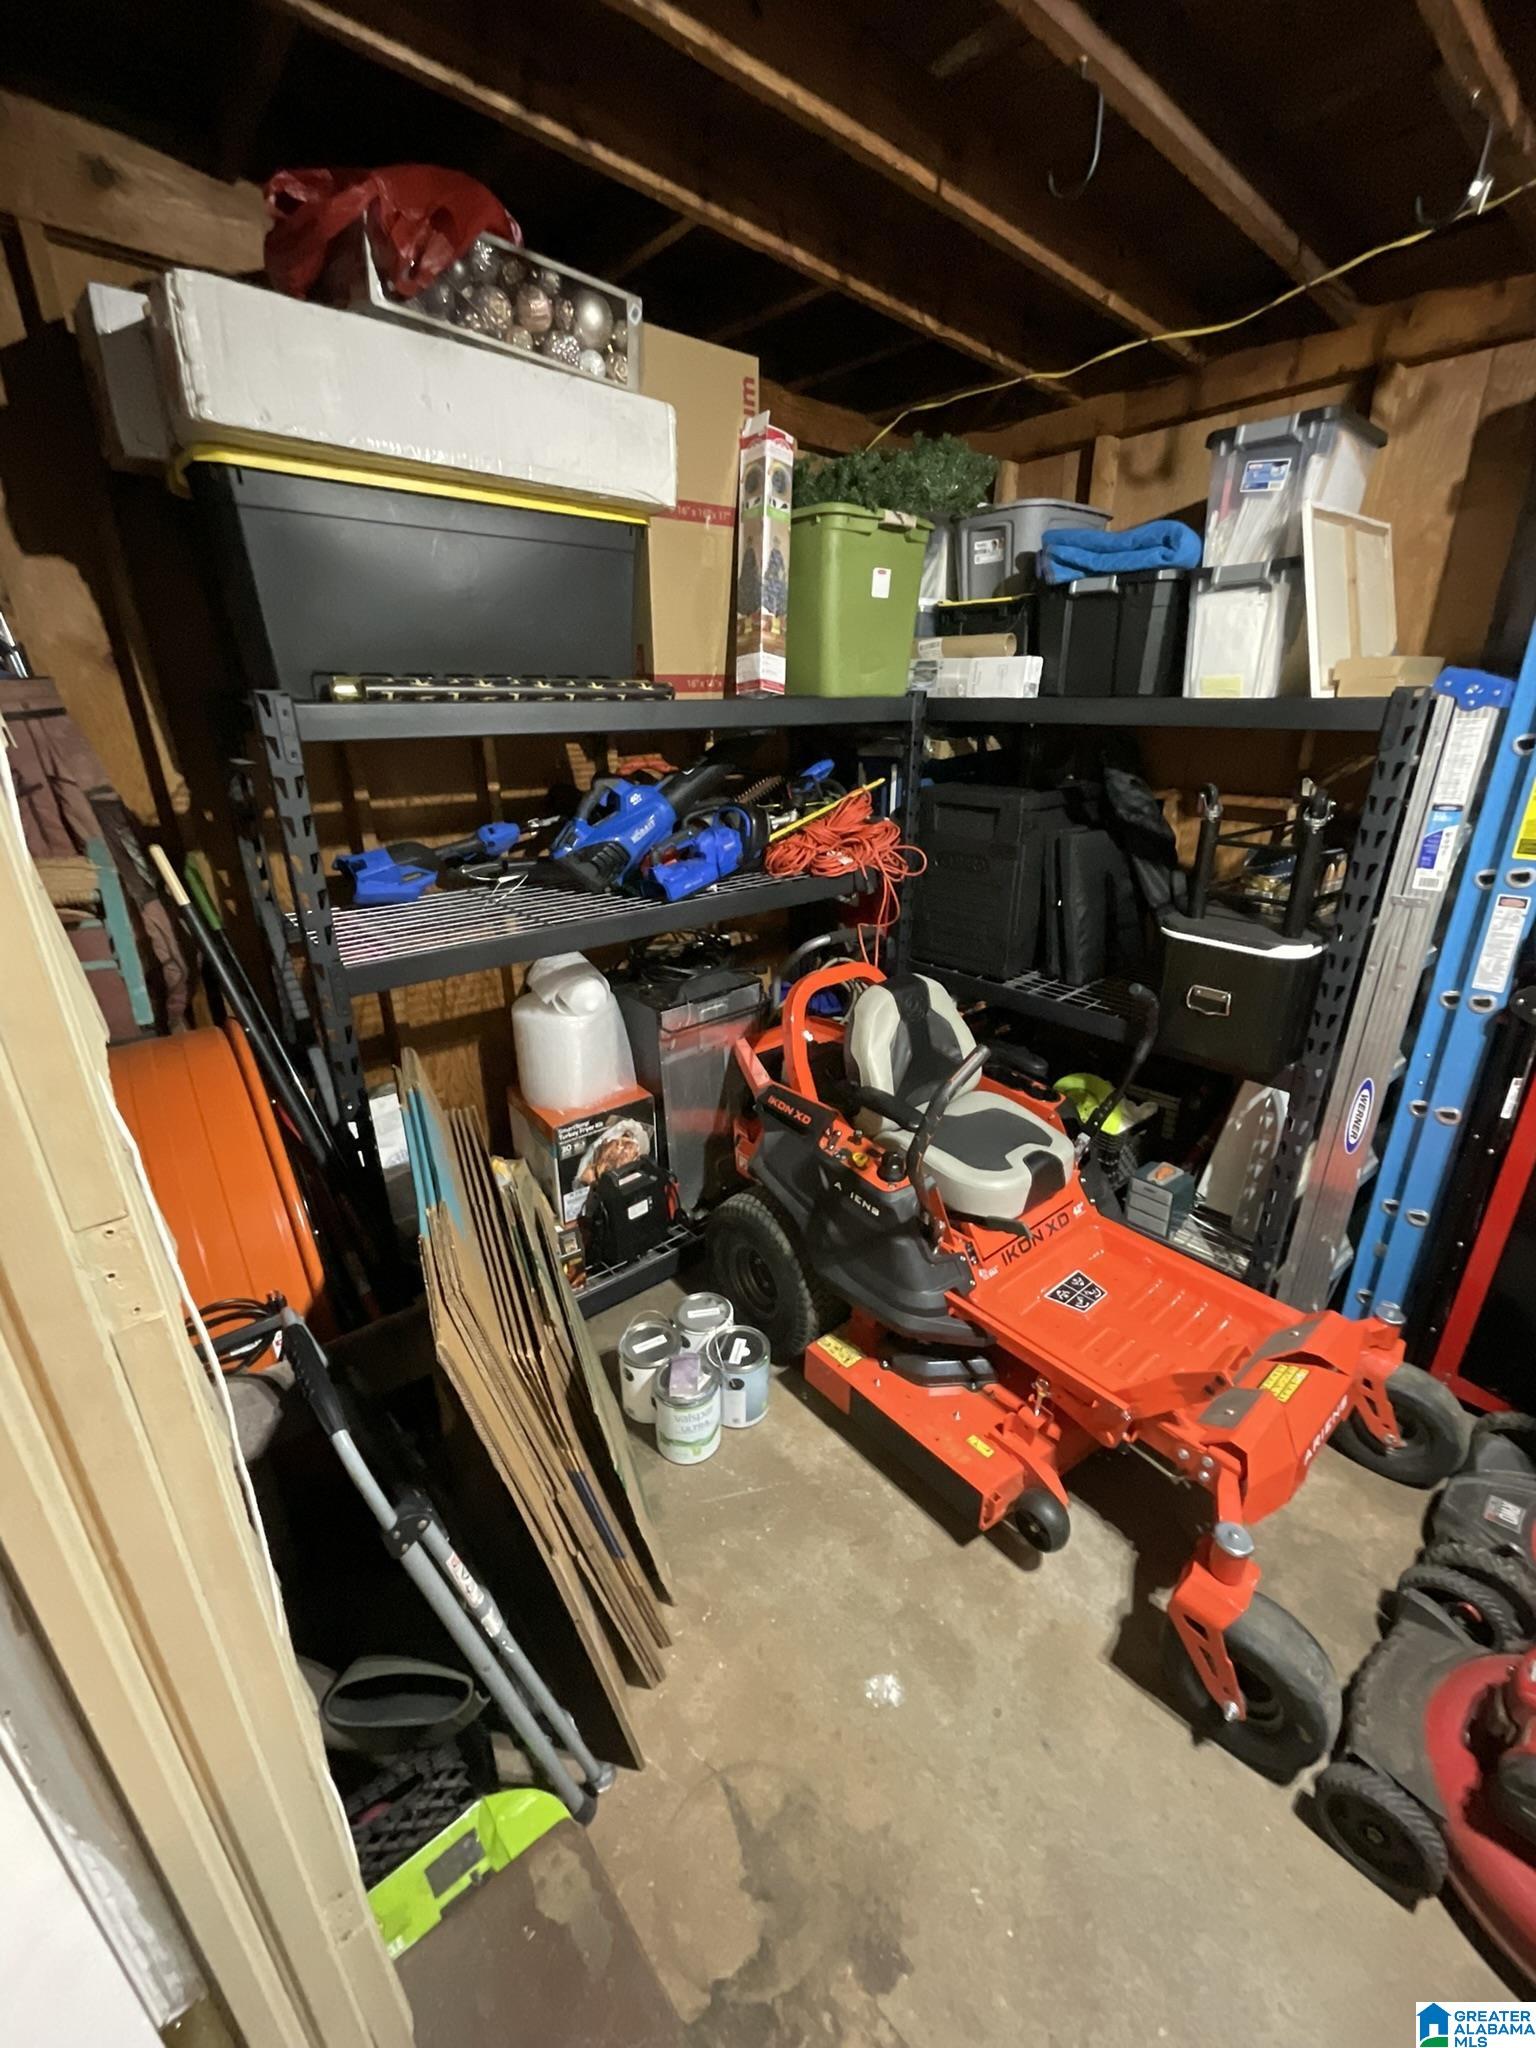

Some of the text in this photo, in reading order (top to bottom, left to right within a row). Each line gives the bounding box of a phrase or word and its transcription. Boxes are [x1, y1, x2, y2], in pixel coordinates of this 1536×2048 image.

[767, 1095, 812, 1125] IKON XD
[1350, 1094, 1369, 1140] WERNER
[1000, 1228, 1045, 1267] IKON
[1045, 1211, 1070, 1237] XD
[1303, 1394, 1348, 1467] ARIENS
